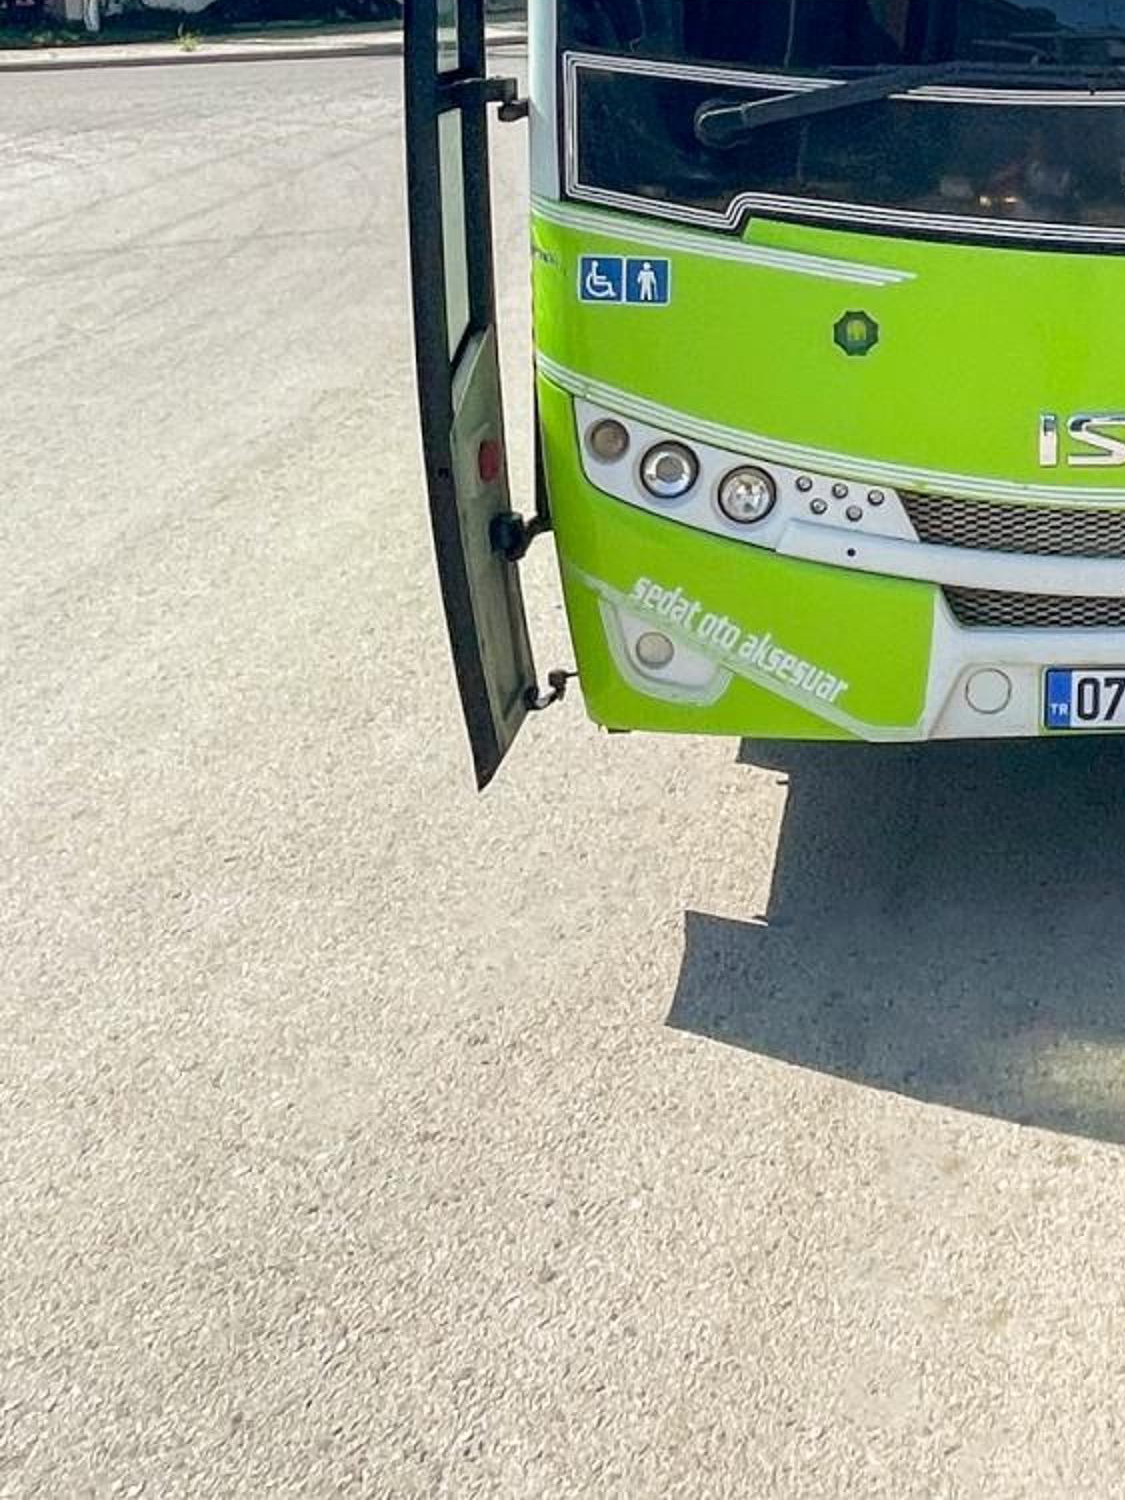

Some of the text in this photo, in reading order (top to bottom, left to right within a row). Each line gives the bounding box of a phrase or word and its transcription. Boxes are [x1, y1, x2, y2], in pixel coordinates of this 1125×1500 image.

[631, 577, 849, 702] sedat oto aksesuar
[1050, 703, 1068, 716] TR
